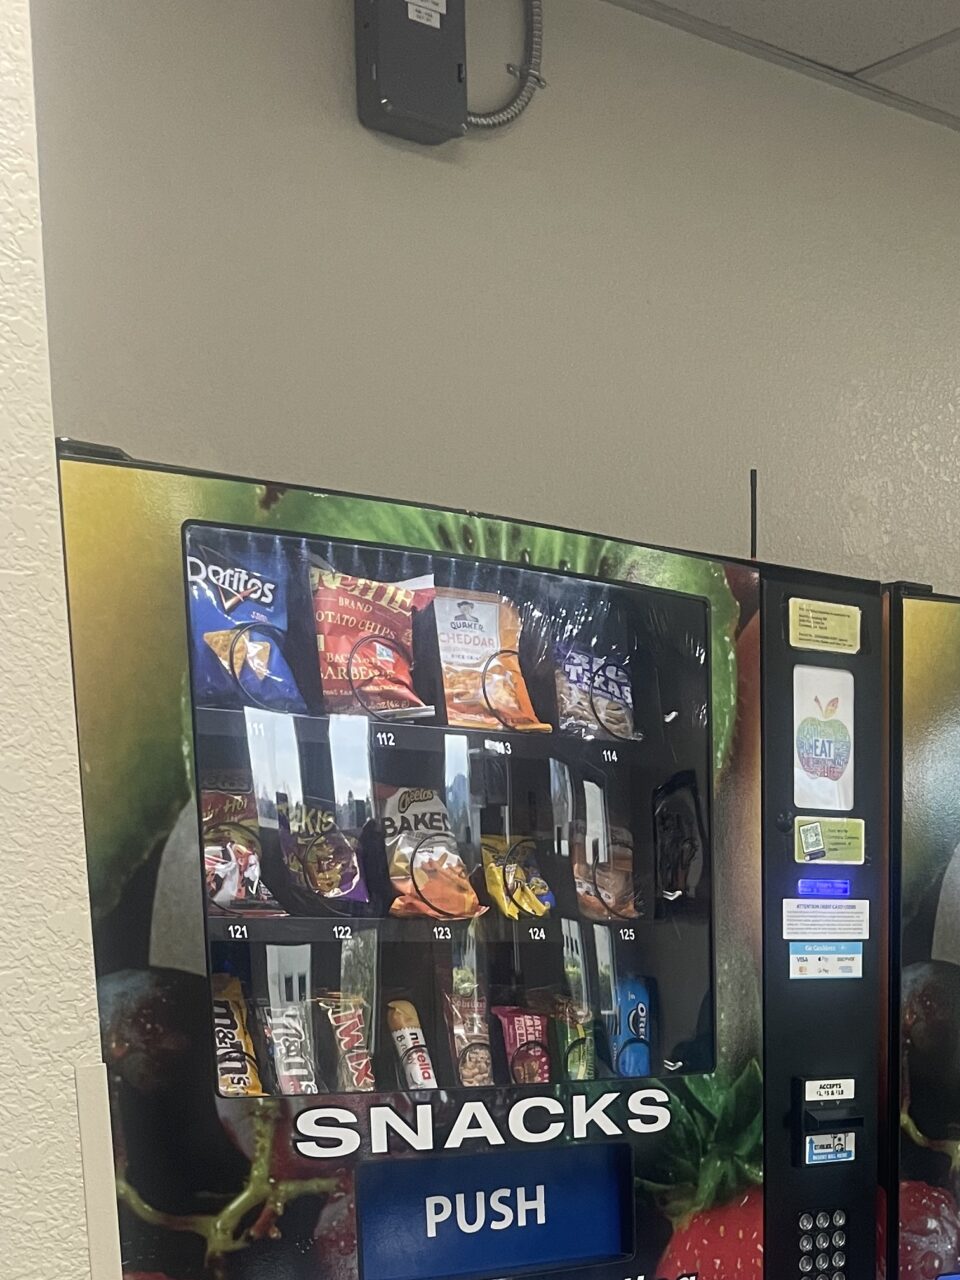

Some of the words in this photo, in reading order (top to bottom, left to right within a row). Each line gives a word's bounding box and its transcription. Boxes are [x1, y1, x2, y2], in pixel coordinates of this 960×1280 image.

[187, 556, 275, 604] Doritos
[338, 596, 373, 612] BRAND
[316, 610, 356, 627] OTATO
[358, 619, 396, 639] CHIPS
[450, 622, 486, 633] QUAKER
[439, 632, 496, 648] CHEDDAR
[377, 732, 396, 746] 112
[603, 750, 618, 762] 114
[814, 739, 834, 758] EAT
[398, 789, 434, 813] Cheetos
[228, 925, 248, 939] 121
[333, 926, 352, 939] 122
[433, 926, 451, 940] 123
[528, 927, 546, 941] 124
[619, 928, 635, 941] 125
[295, 1088, 672, 1159] SNACKS
[425, 1184, 547, 1238] PUSH
